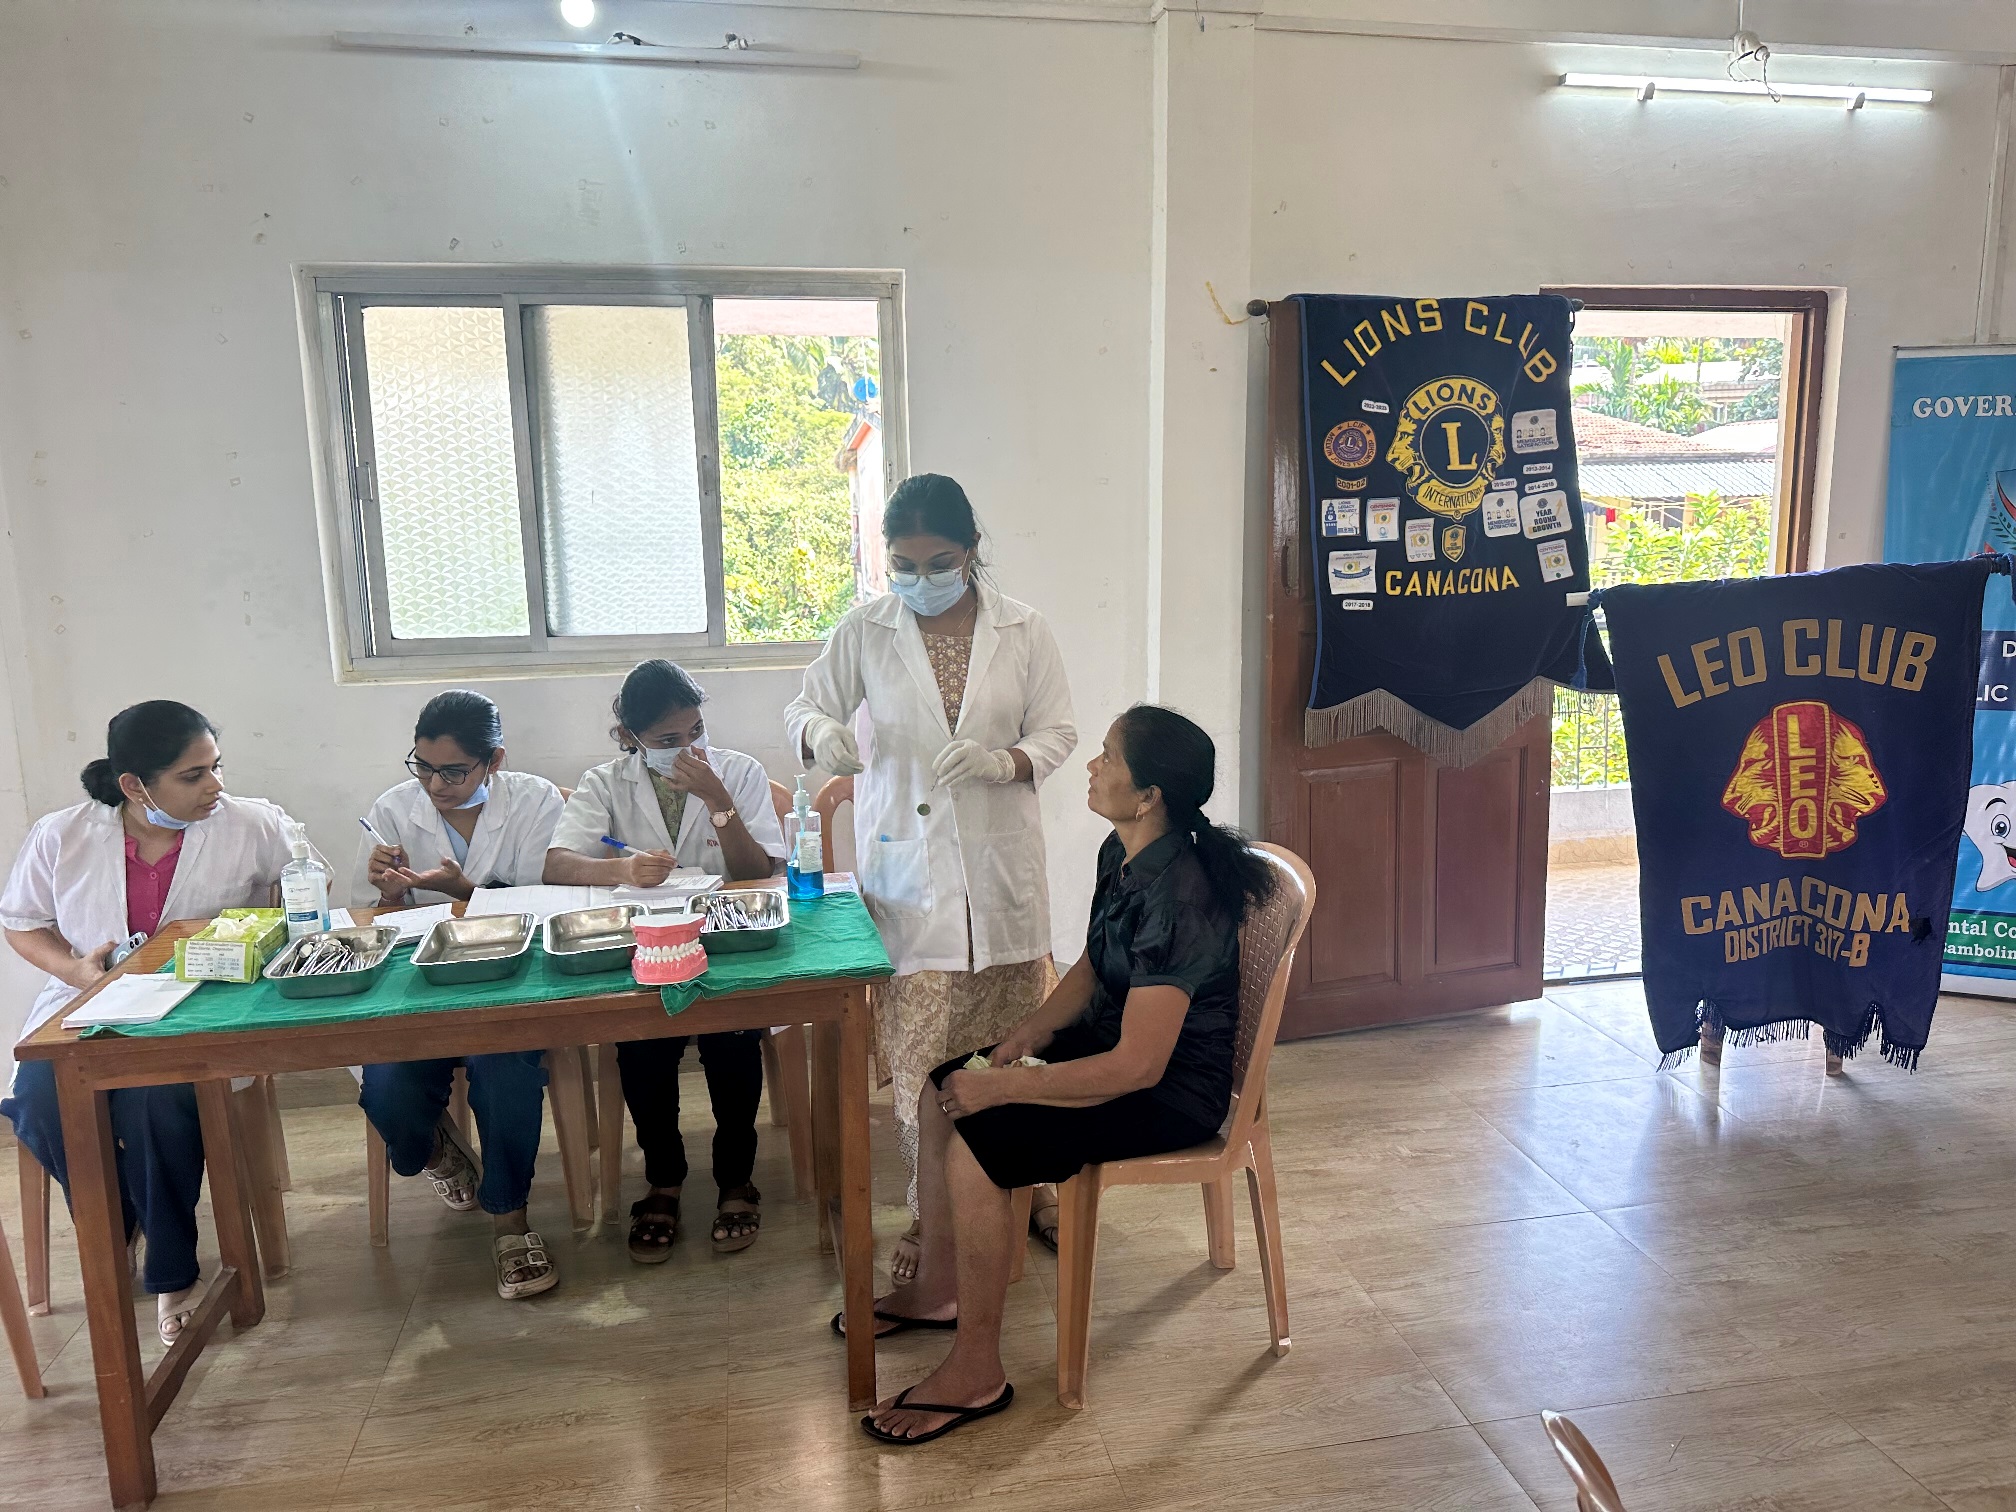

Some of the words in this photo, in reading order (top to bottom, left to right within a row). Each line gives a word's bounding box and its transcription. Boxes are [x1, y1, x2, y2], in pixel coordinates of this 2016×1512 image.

[1320, 298, 1442, 387] LIONS
[1465, 301, 1557, 383] CLUB
[1412, 383, 1492, 415] LIONS
[1912, 395, 2016, 418] GOVER
[1441, 421, 1478, 471] L
[1337, 478, 1366, 490] 2001-02
[1532, 521, 1562, 533] GROWTH
[1534, 515, 1557, 526] ROUND
[1535, 508, 1553, 518] YEAR
[1385, 565, 1520, 597] CANACONA
[1657, 626, 1767, 708] LEO
[1783, 618, 1937, 692] CLUB
[1787, 714, 1818, 839] LEO
[1681, 875, 1910, 935] CANACONA
[1724, 914, 1812, 963] DISTRICT
[1814, 922, 1871, 968] 317-B
